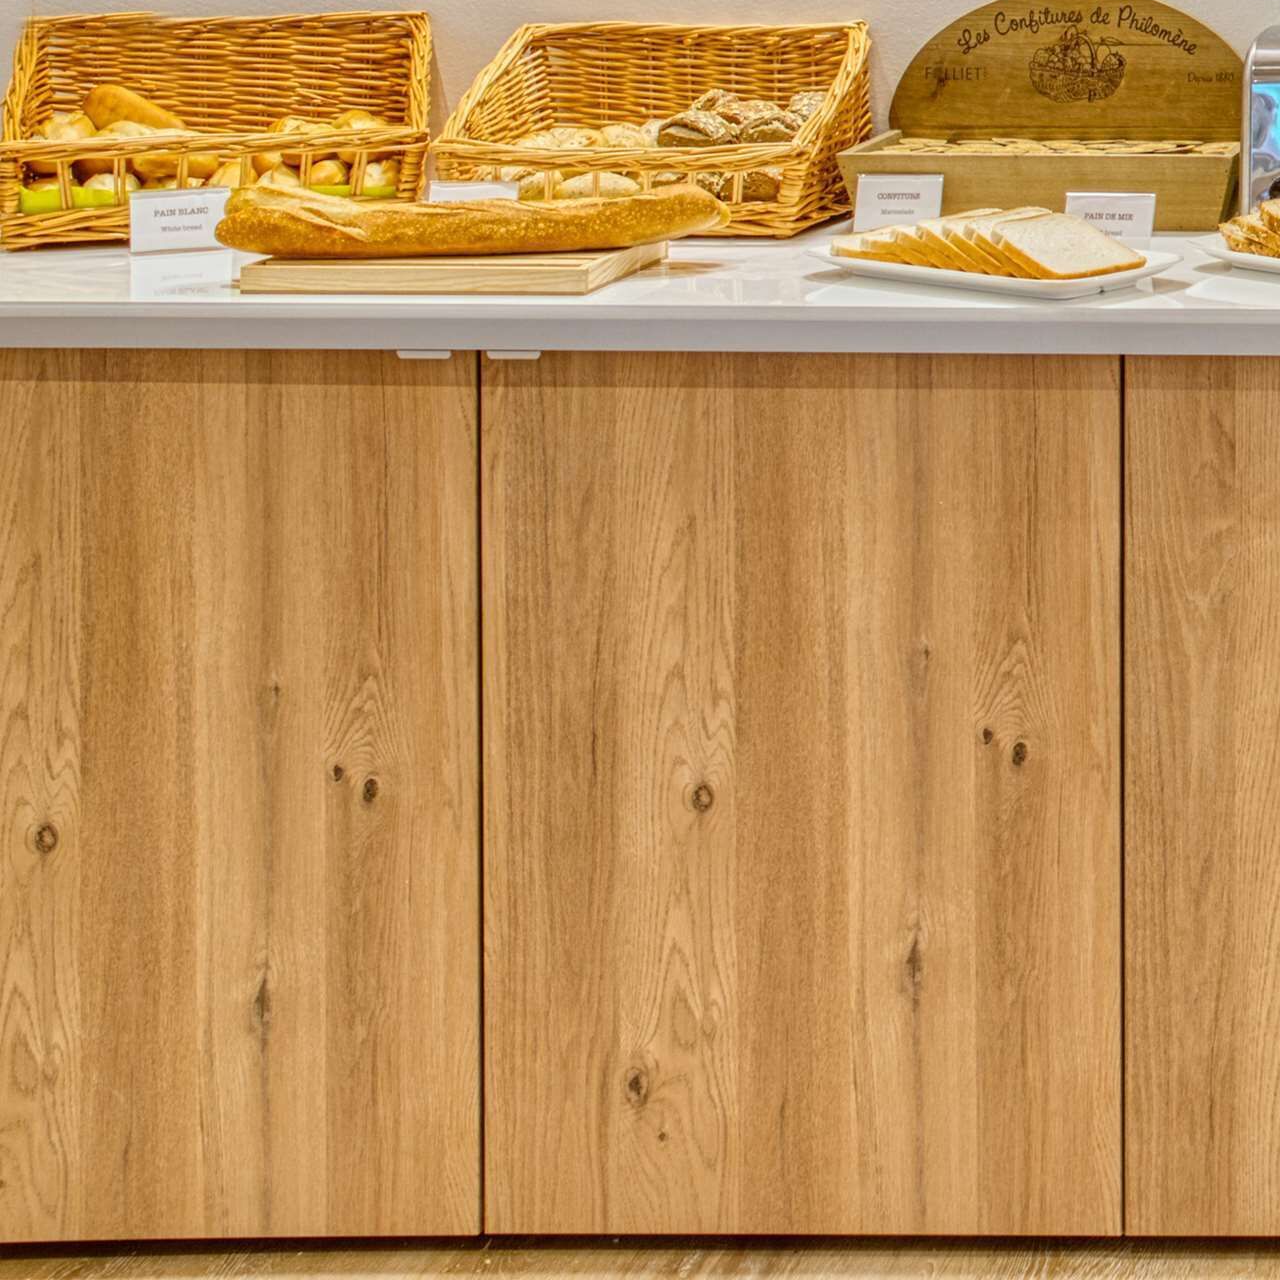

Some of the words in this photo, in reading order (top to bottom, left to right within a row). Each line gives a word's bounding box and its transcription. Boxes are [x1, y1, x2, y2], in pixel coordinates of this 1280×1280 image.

[957, 28, 990, 55] Les
[994, 7, 1083, 36] Confitures
[1090, 6, 1110, 25] de
[1118, 4, 1198, 56] Philomène
[877, 192, 921, 200] CONFITURE
[154, 209, 177, 218] PAIN
[178, 207, 208, 216] BLANC
[1084, 212, 1104, 220] PAIN
[1105, 212, 1117, 220] DE
